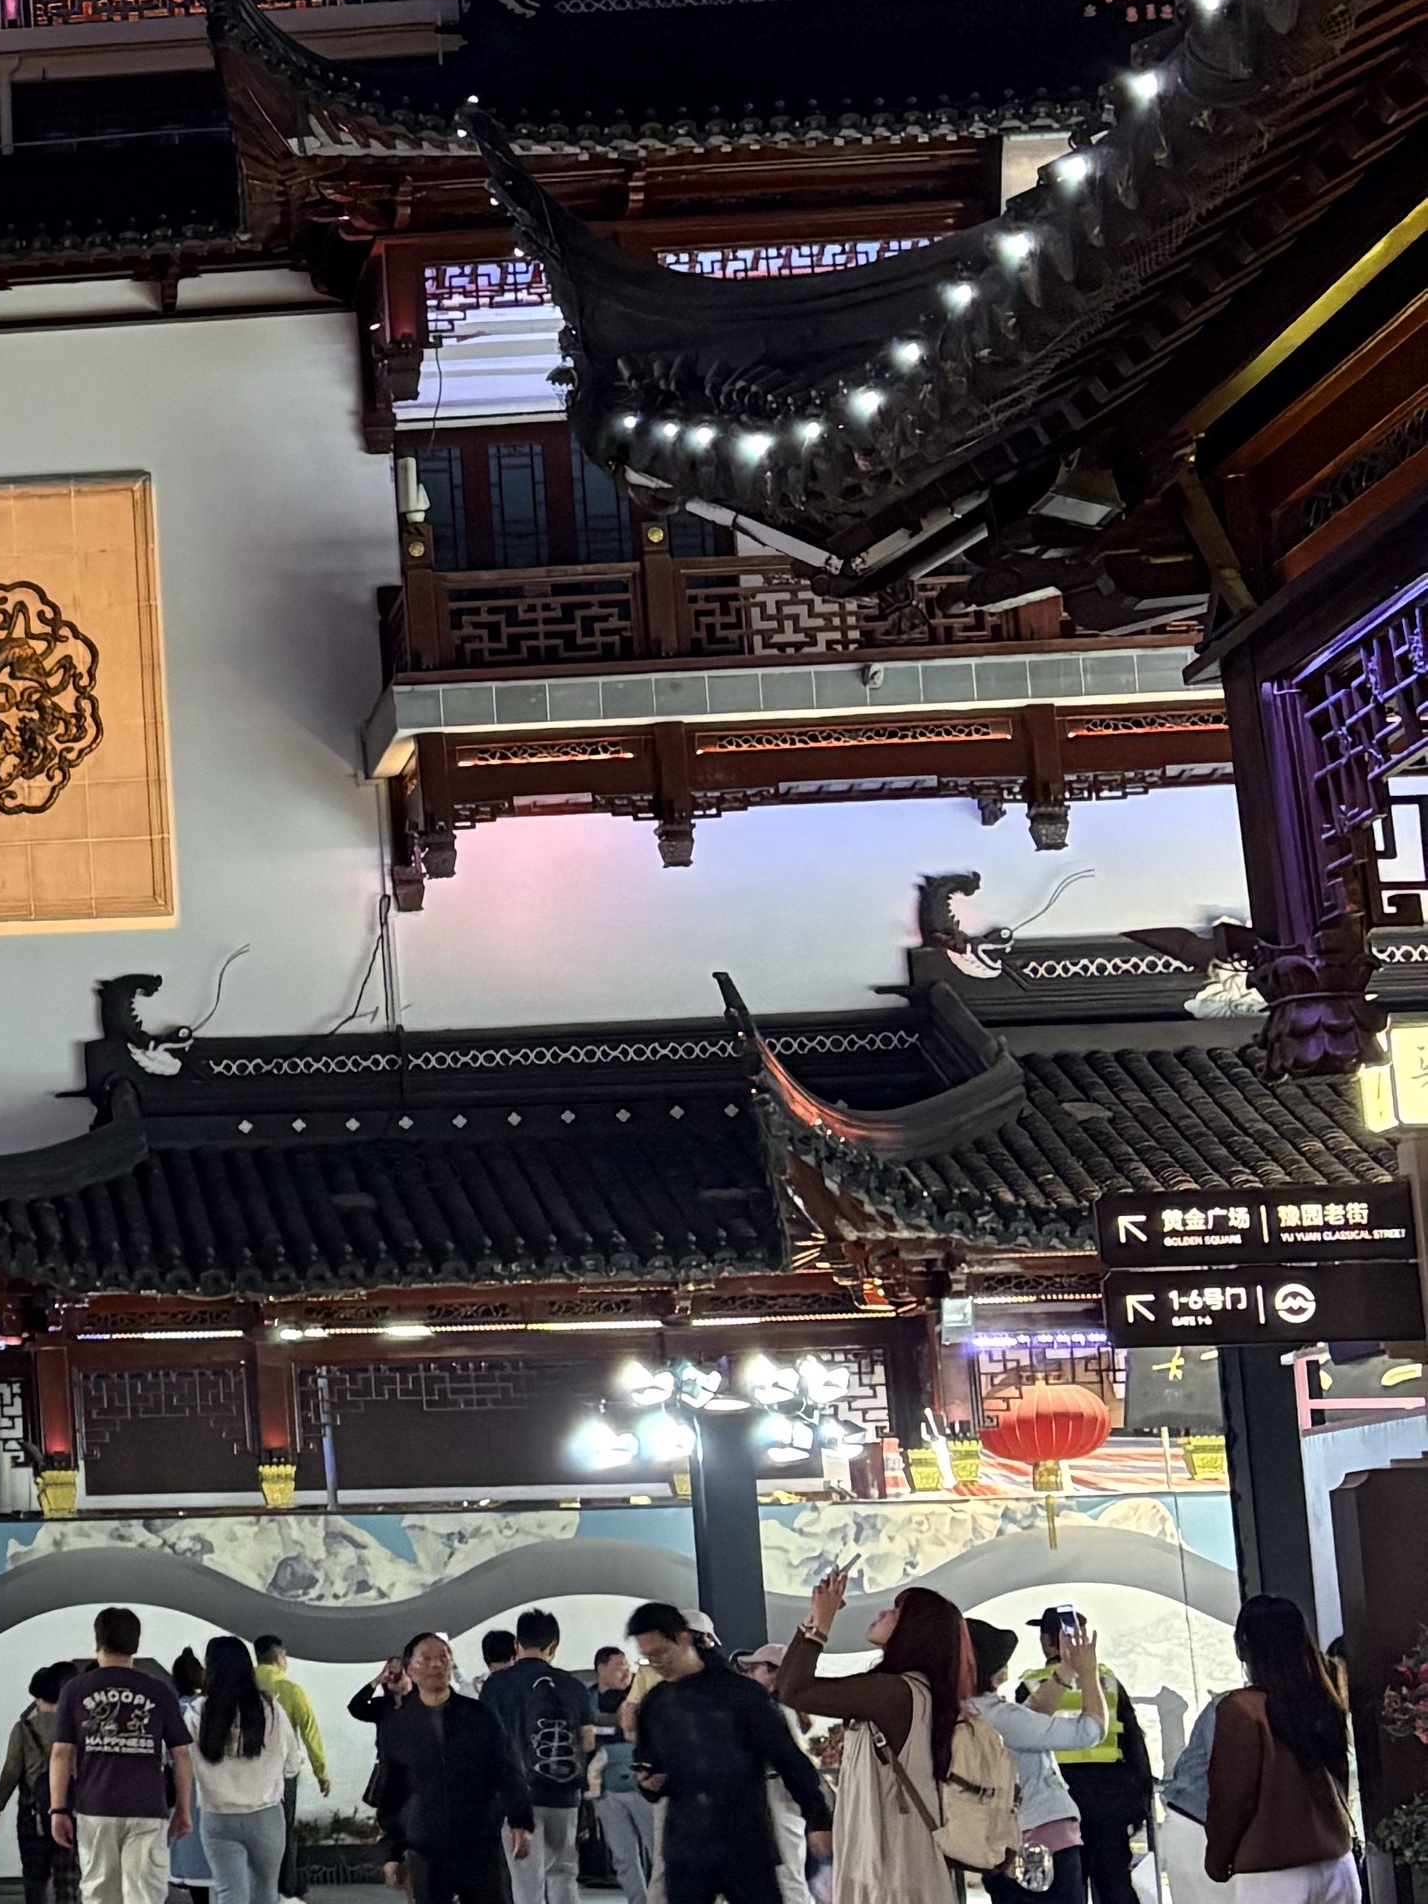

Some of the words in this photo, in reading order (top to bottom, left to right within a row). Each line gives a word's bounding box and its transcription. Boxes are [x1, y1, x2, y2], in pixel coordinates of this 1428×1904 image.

[1161, 1207, 1250, 1233] 黄金广场
[1277, 1203, 1369, 1228] 豫园老街
[1164, 1236, 1203, 1247] GOLDEN
[1204, 1234, 1242, 1246] SQUARE
[1281, 1232, 1295, 1243] YU
[1296, 1231, 1322, 1242] YUAN
[1323, 1230, 1373, 1241] CLASSICAL
[1374, 1228, 1406, 1239] STREET
[1168, 1286, 1248, 1311] 1-6号门
[1171, 1316, 1197, 1327] GATE
[82, 1690, 156, 1711] SNOOPY
